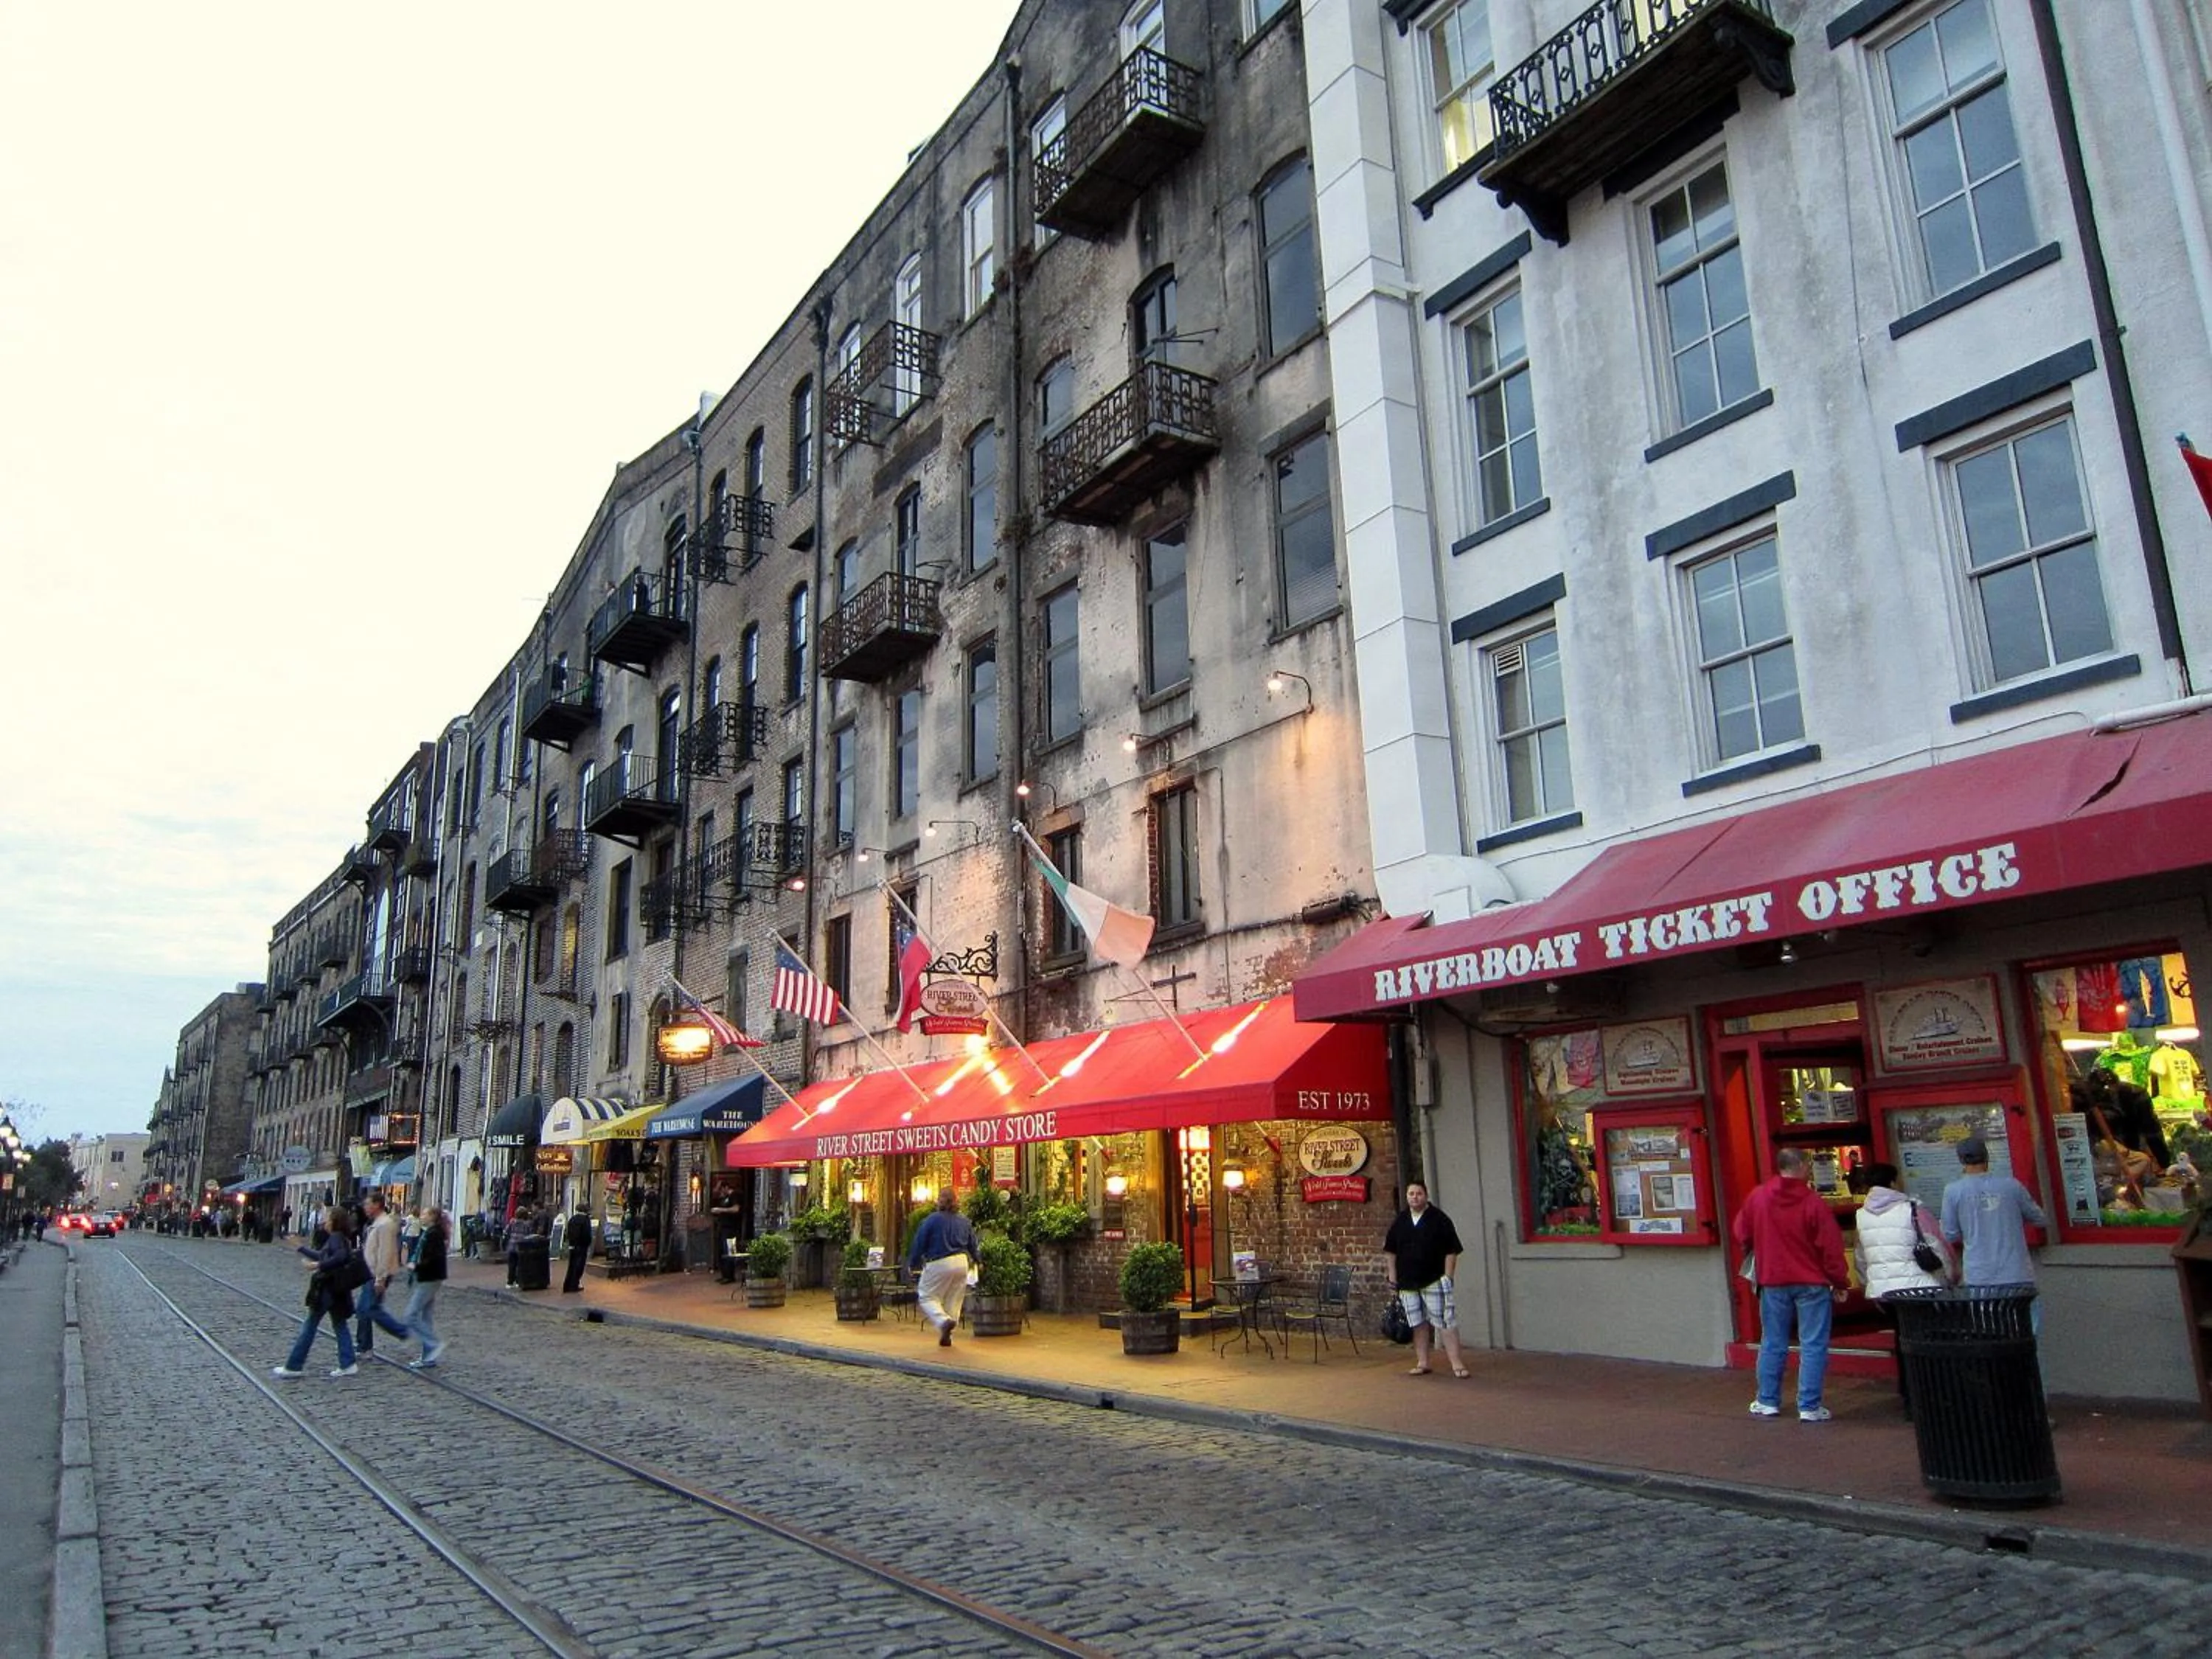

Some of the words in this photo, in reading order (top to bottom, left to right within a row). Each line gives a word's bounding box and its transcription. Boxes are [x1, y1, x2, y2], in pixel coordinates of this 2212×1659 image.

[1374, 932, 1581, 1001] RIVERBOAT
[1599, 892, 1773, 959] TICKET
[1798, 842, 2020, 920] OFFICE
[1298, 1091, 1330, 1110] EST
[1337, 1092, 1371, 1110] 1973
[723, 1110, 743, 1119] THE
[816, 1135, 848, 1156] RIVER
[850, 1130, 894, 1154] STREET
[897, 1124, 947, 1150] SWEETS
[950, 1118, 1002, 1146] CANDY
[1005, 1111, 1057, 1143] STORE
[1304, 1141, 1329, 1155] RIVER
[1329, 1138, 1360, 1152] STREET
